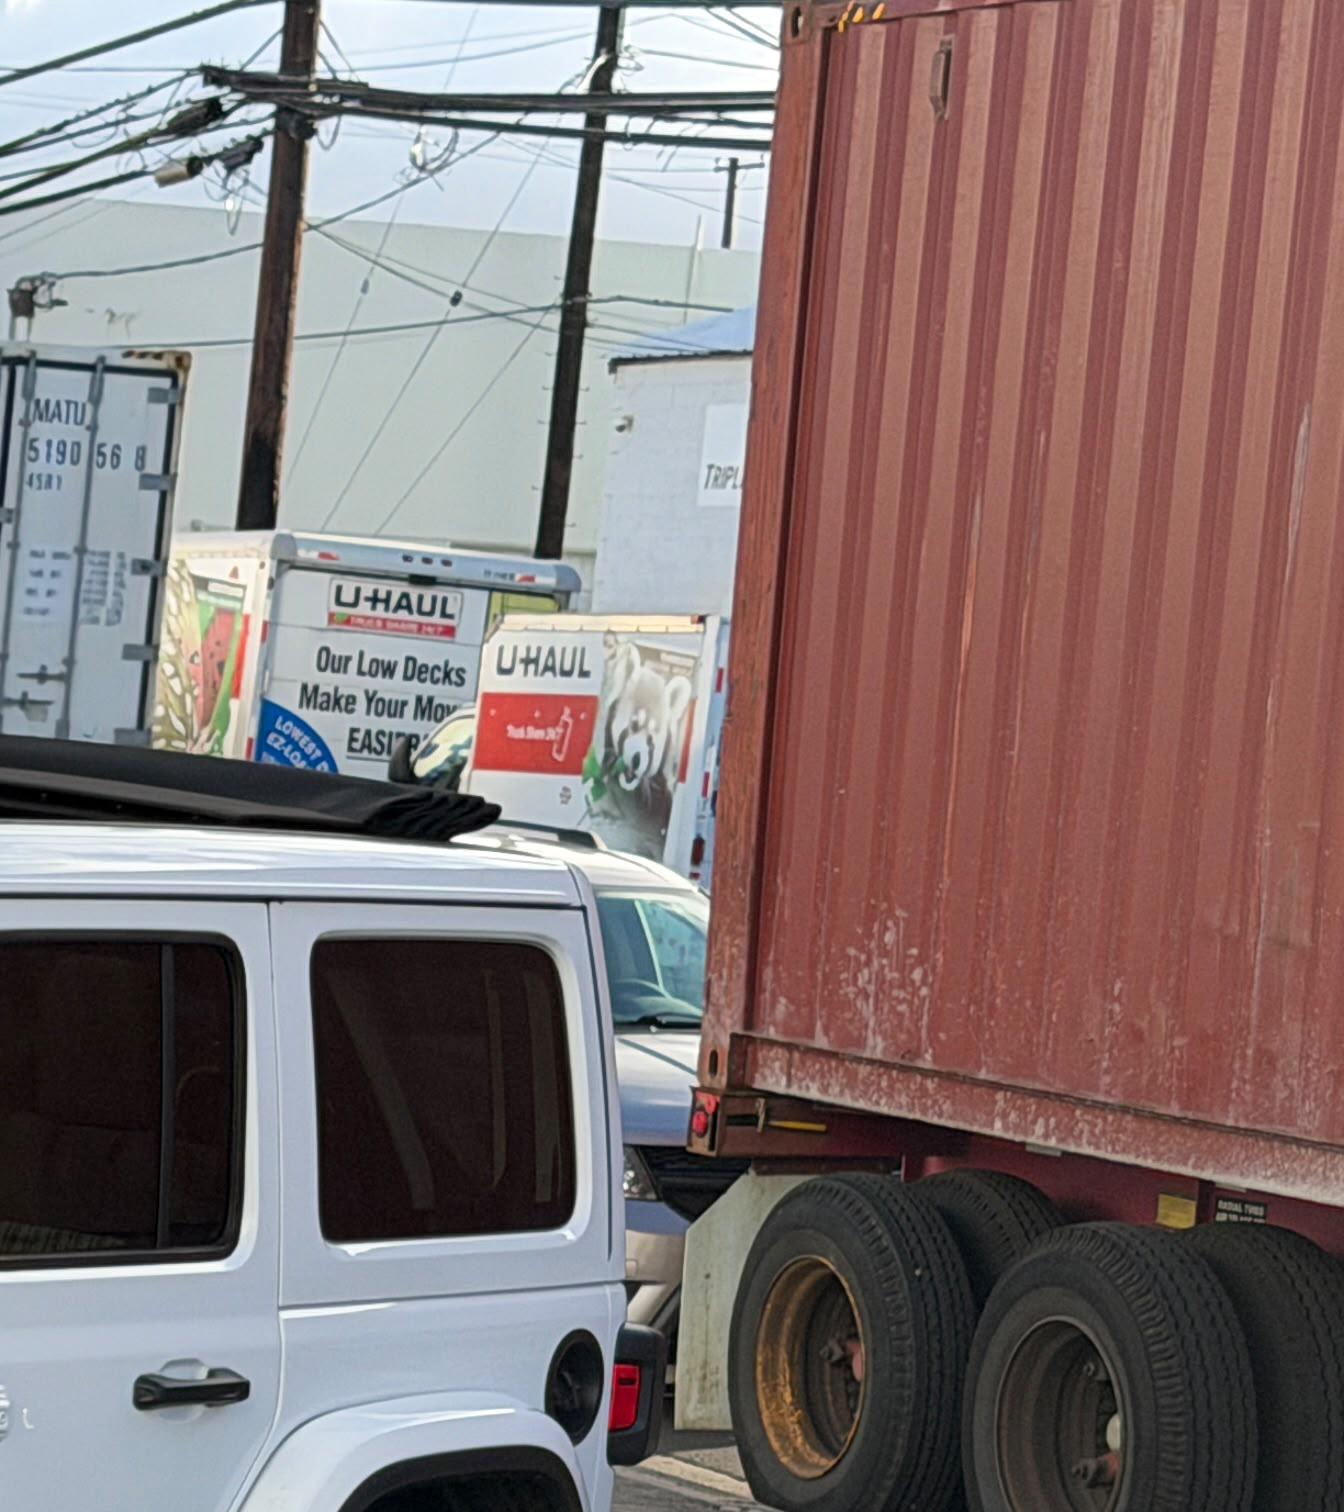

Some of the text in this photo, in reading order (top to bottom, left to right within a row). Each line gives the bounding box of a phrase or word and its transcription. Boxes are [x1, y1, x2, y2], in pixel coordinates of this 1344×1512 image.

[32, 397, 87, 426] MATU
[134, 443, 148, 473] 8
[334, 583, 456, 620] U-HAUL
[316, 646, 467, 688] Our Low Decks
[496, 644, 592, 679] U-HAUL
[298, 682, 462, 724] Make Your Mov
[274, 715, 322, 761] LOWEST
